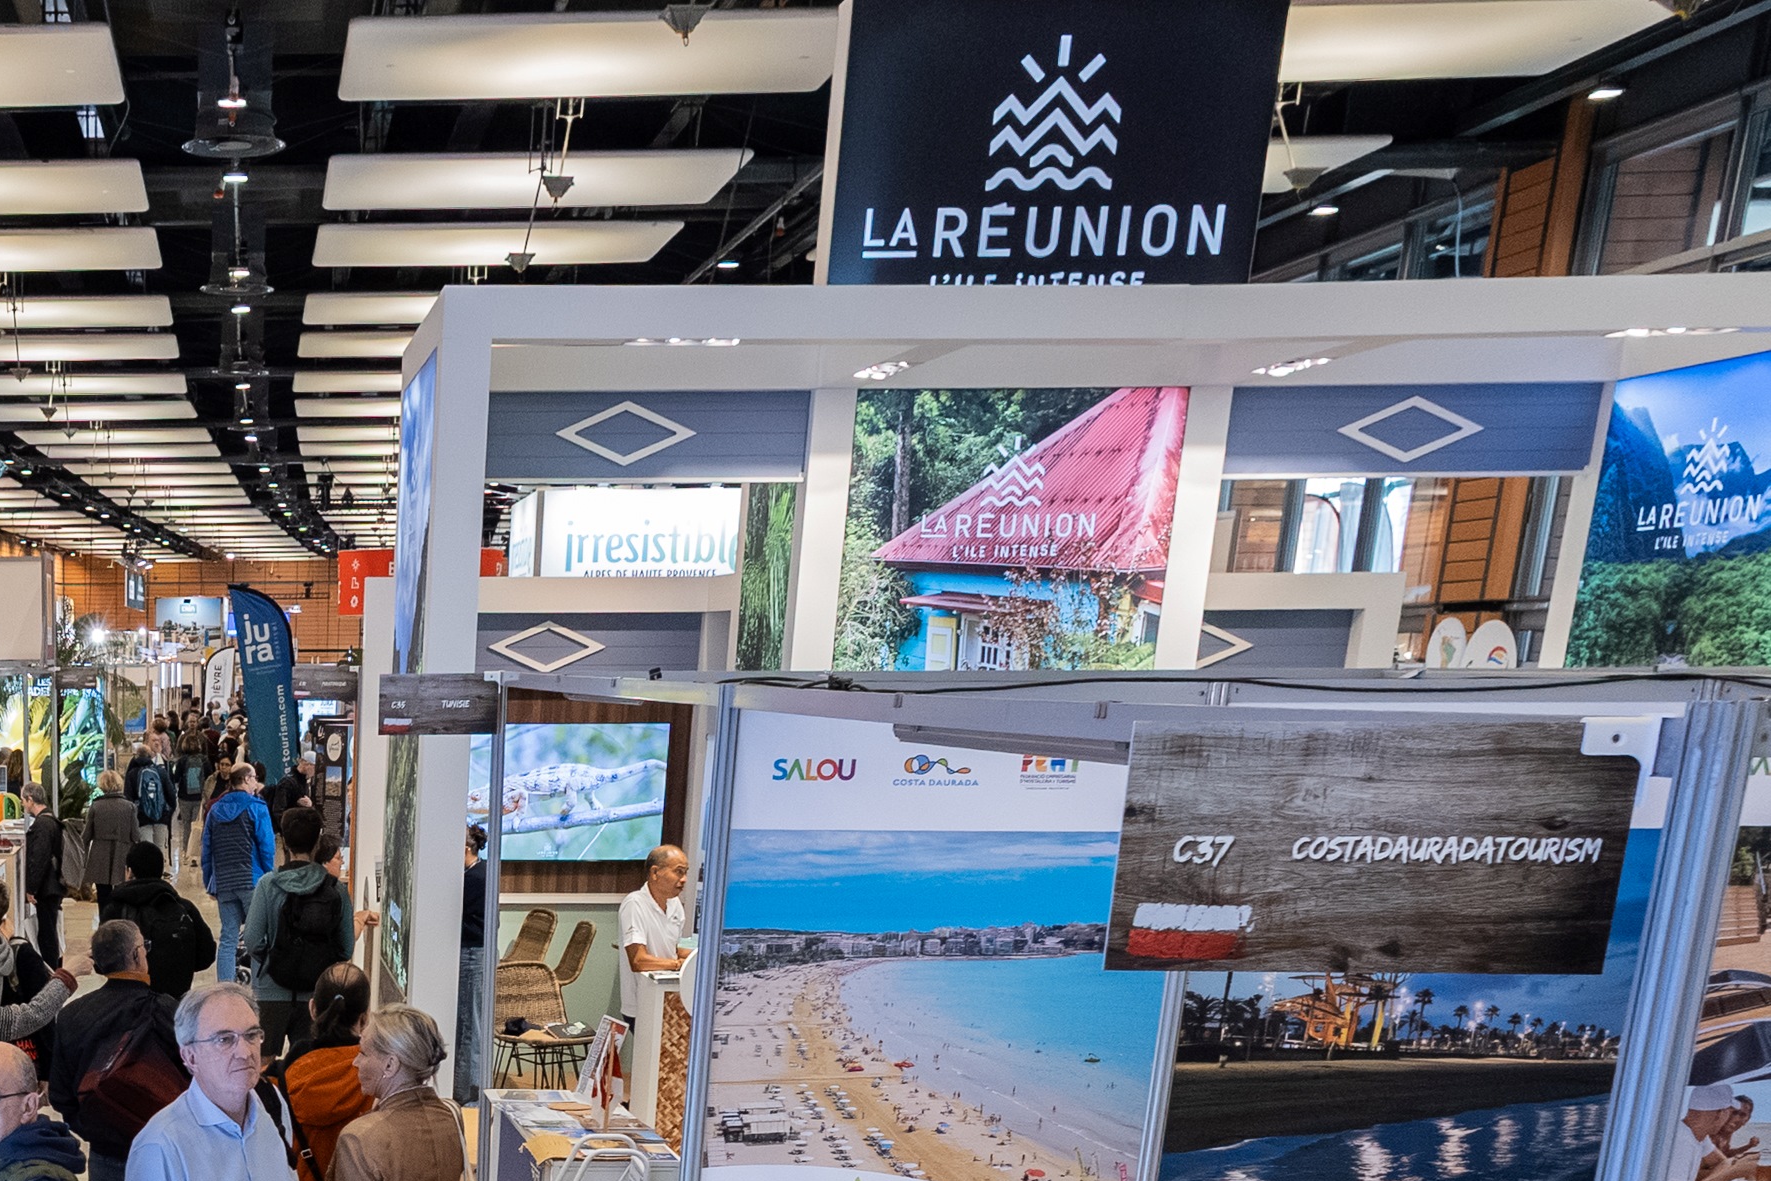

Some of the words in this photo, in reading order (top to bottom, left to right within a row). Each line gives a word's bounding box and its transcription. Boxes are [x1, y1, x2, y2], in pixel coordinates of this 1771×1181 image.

[862, 207, 918, 258] LA
[931, 201, 1227, 259] RÉUNION
[920, 513, 948, 538] LA
[954, 512, 1097, 539] RÉUNION
[1636, 505, 1657, 530] LA
[1658, 493, 1762, 530] RÉUNION
[243, 613, 271, 643] ju
[245, 642, 275, 665] ra
[441, 699, 471, 709] TUNISIE
[277, 684, 292, 777] a-tourism.com
[772, 757, 858, 782] SALOU
[892, 778, 926, 787] COSTA
[928, 778, 979, 787] DAURADA
[1172, 834, 1236, 868] C37
[1291, 834, 1604, 866] COSTADAURADATOURISM
